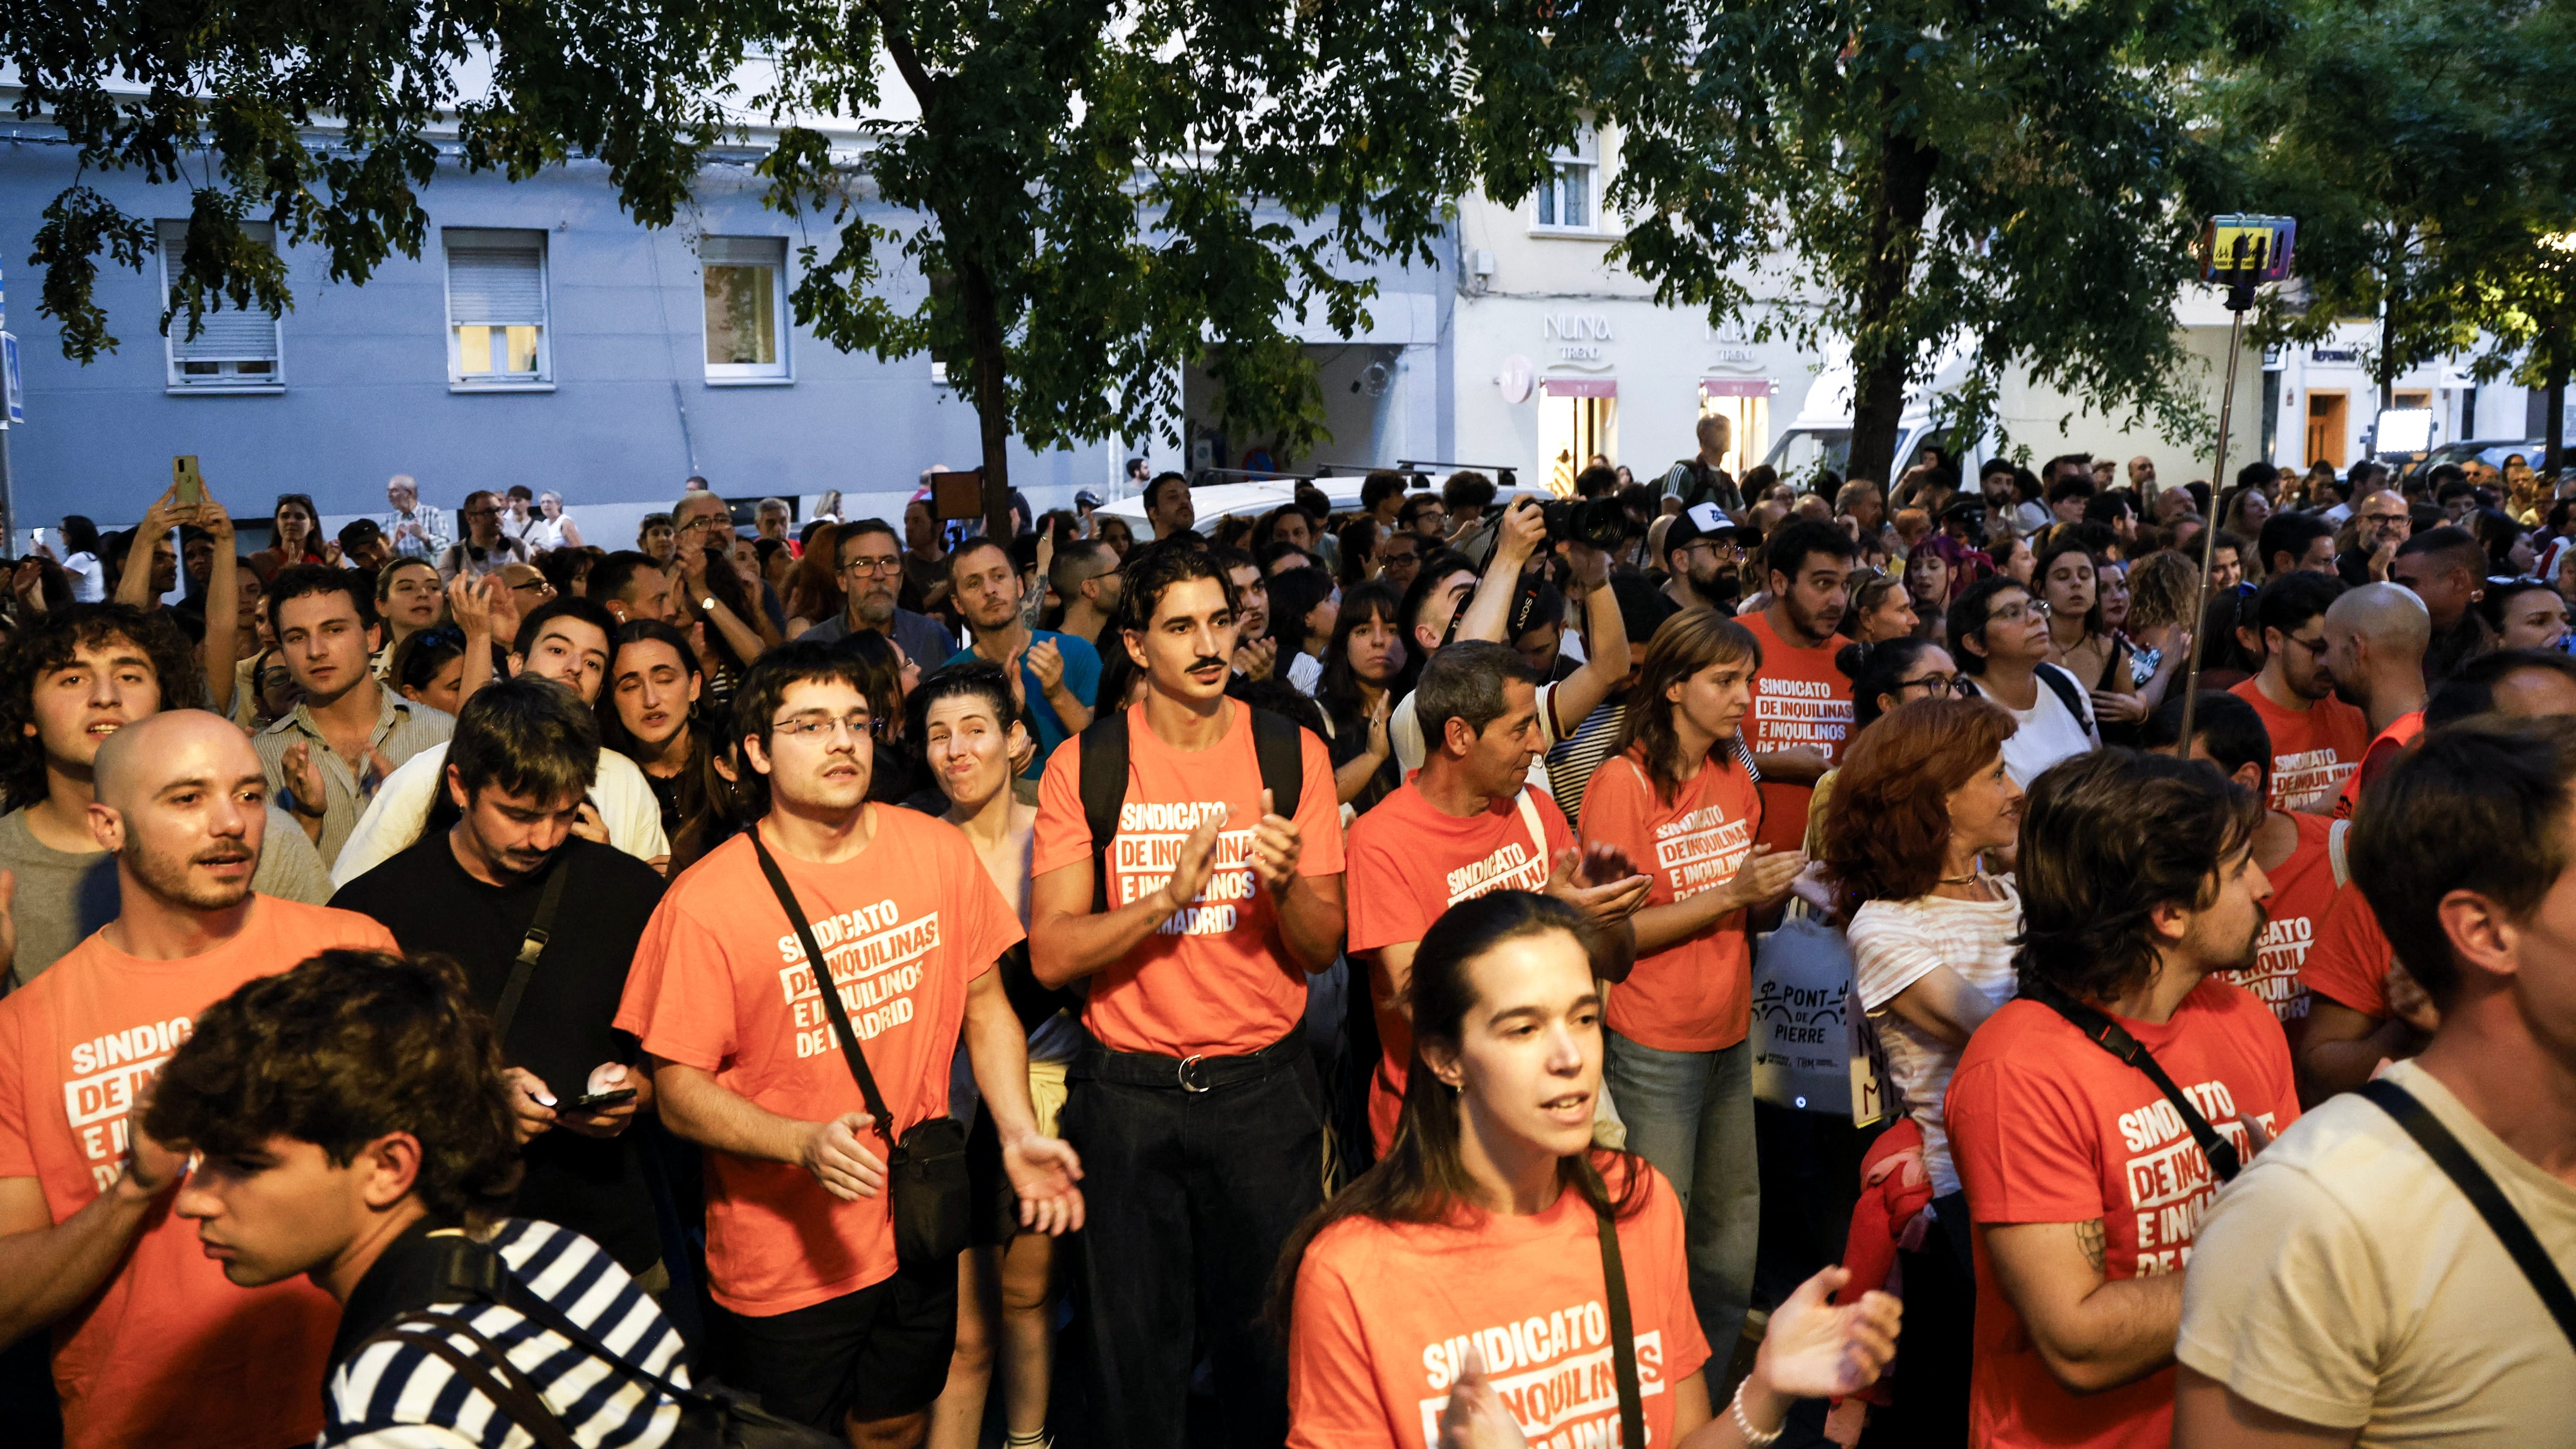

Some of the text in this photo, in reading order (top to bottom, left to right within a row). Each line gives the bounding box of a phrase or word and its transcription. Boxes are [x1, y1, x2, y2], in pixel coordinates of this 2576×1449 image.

[1544, 314, 1613, 340] NUNA
[1560, 347, 1600, 360] TREND
[1517, 598, 1533, 630] SONY
[1759, 677, 1831, 698] SINDICATO
[1760, 701, 1853, 719] DE INQUILINAS
[1758, 721, 1846, 740] E INQUILINOS
[1122, 840, 1147, 866] DE
[1663, 842, 1687, 862] DE
[1447, 842, 1526, 896] SINDICATO
[1670, 869, 1683, 888] E
[1122, 876, 1136, 904] E
[824, 920, 935, 978] NQUILINAS
[1783, 984, 1828, 1008] PONT
[793, 1003, 809, 1028] E
[1795, 1011, 1809, 1022] DE
[71, 1016, 193, 1075] SINDIC
[796, 1028, 827, 1058] DE
[1775, 1023, 1826, 1044] PIERRE
[78, 1077, 123, 1116] DE
[83, 1126, 107, 1160] E
[2133, 1159, 2171, 1200] DE
[2137, 1212, 2156, 1249] E
[1498, 1345, 1663, 1427] NQUILINS
